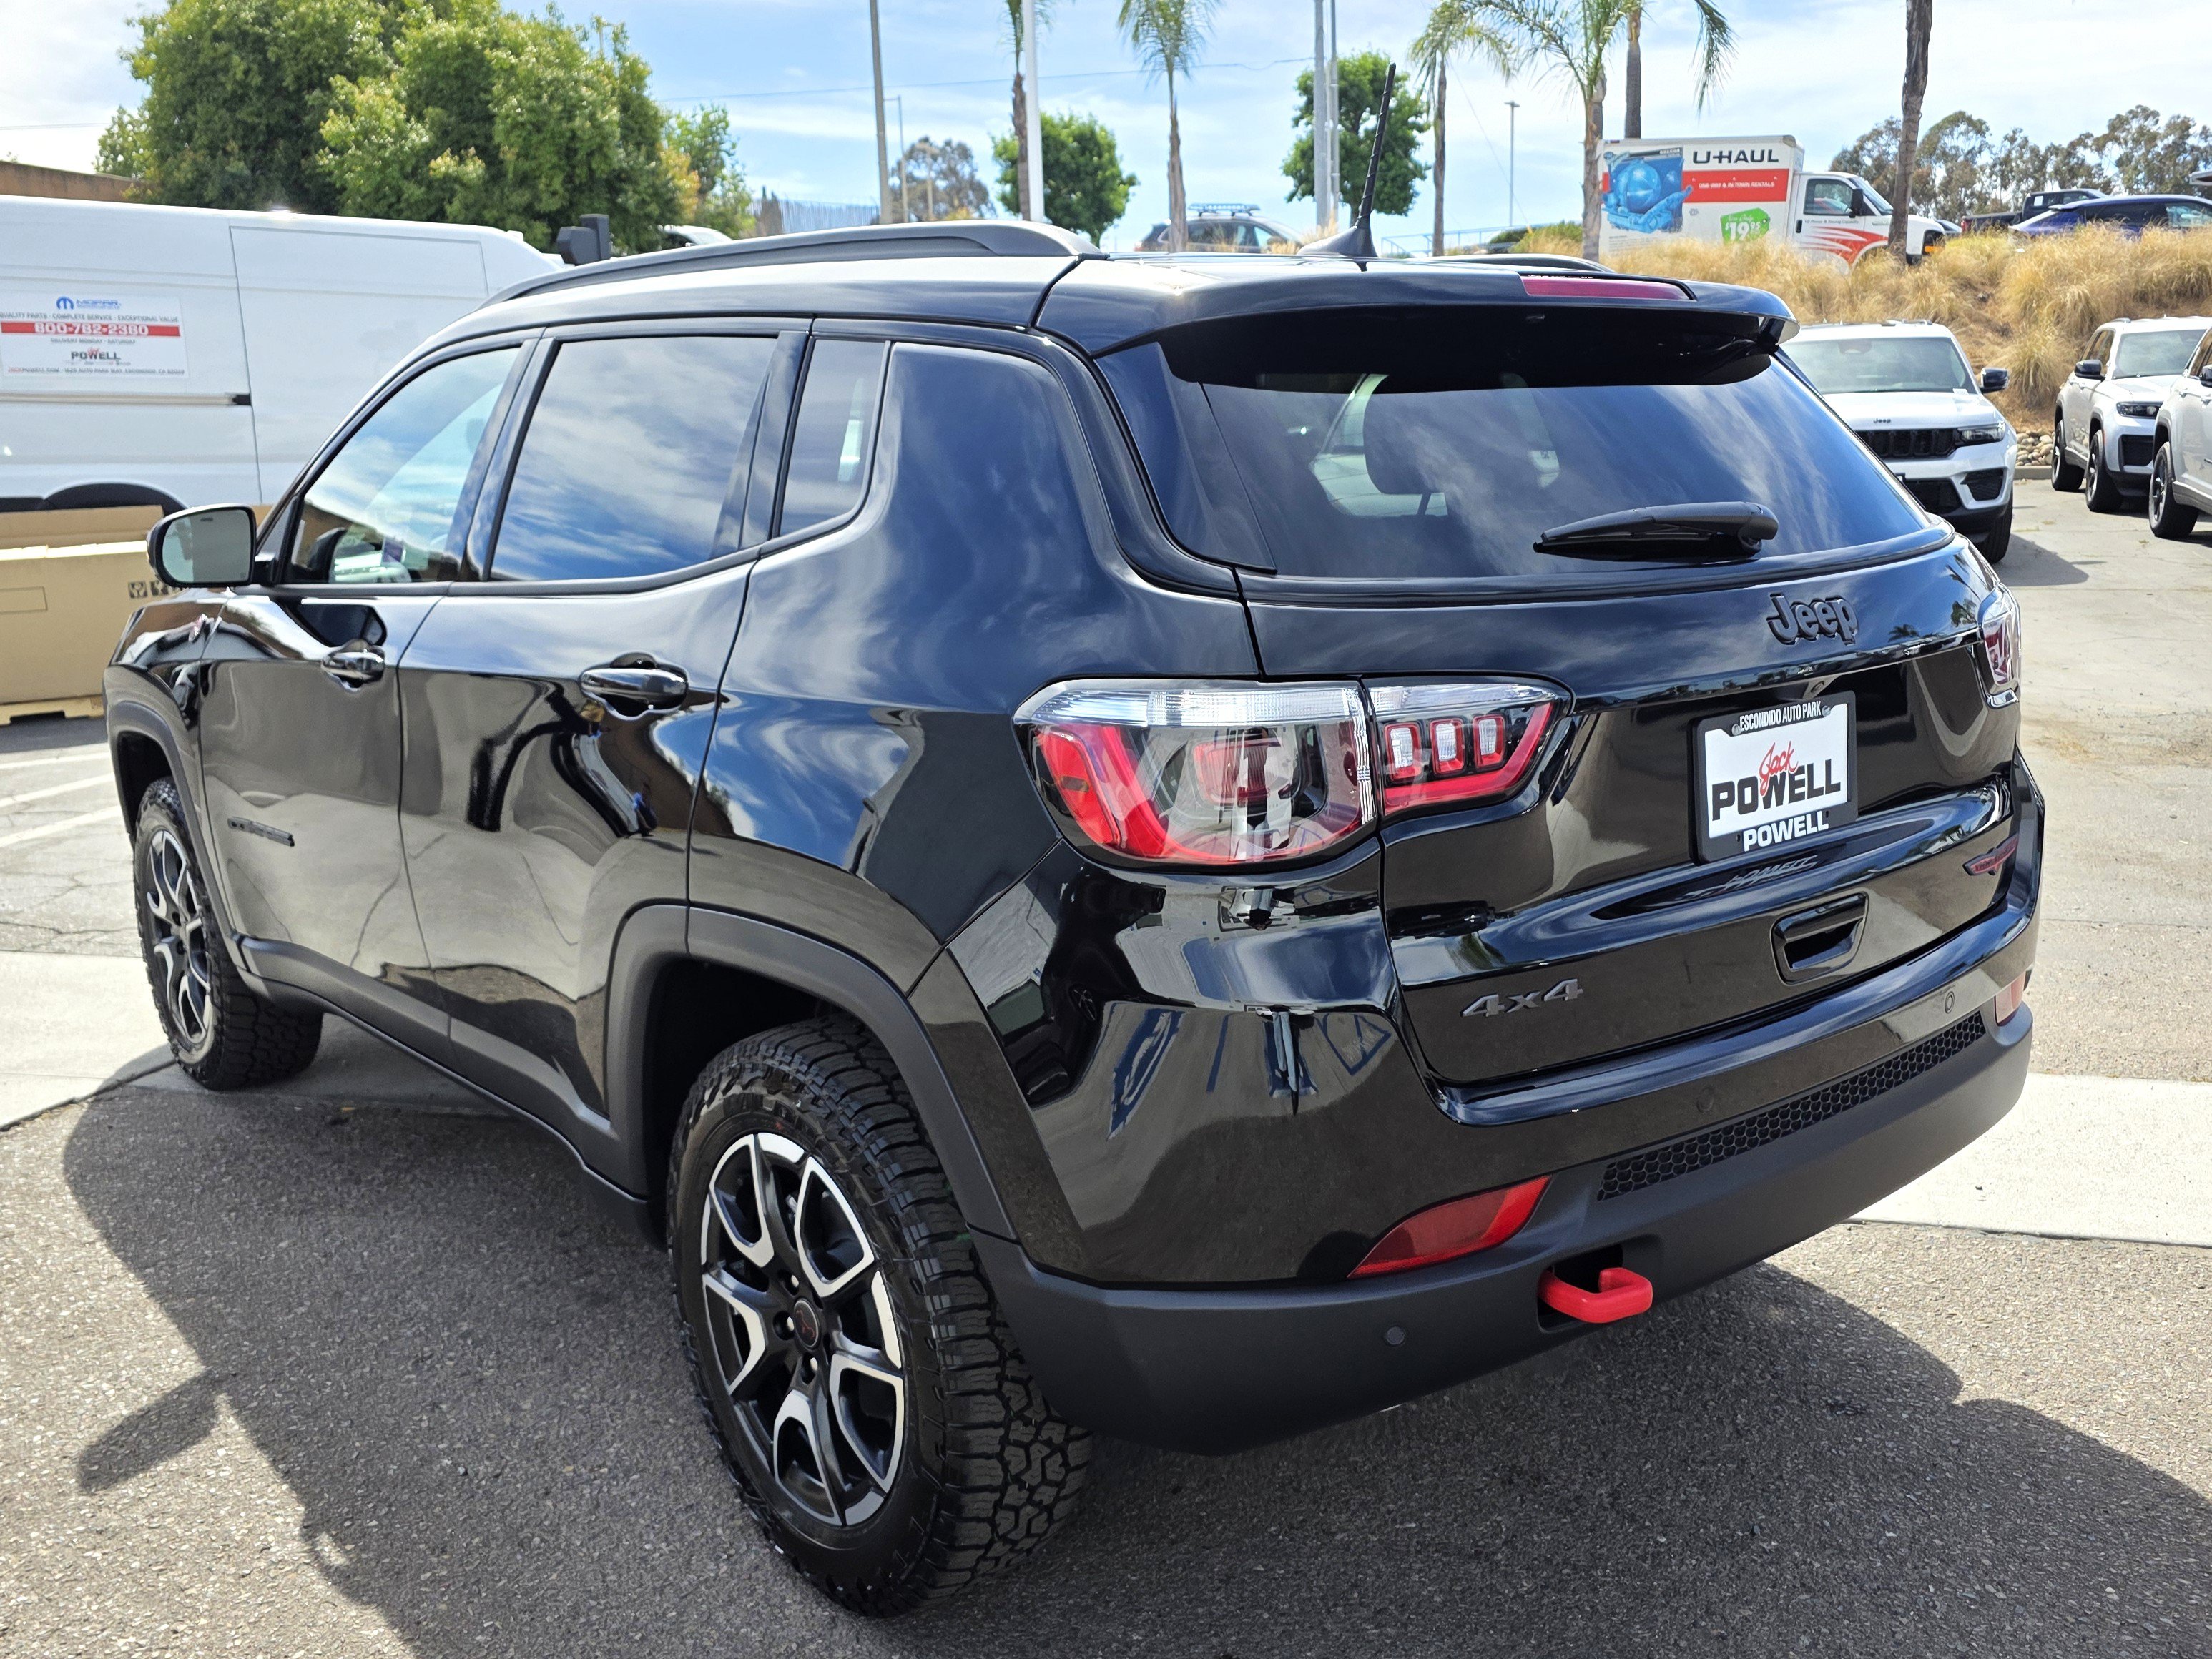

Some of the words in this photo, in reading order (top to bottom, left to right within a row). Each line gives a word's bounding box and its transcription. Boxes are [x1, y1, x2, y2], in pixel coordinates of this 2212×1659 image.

[1693, 148, 1779, 164] U-HAUL
[34, 322, 149, 336] 800-782-2380
[70, 351, 122, 360] POWELL
[1766, 592, 1858, 646] Jeep
[1739, 712, 1781, 731] ESCONDIDO
[1781, 704, 1801, 724] AUTO
[1802, 700, 1822, 719] PARK
[1759, 740, 1799, 797] Jack
[1711, 759, 1842, 822] POWELL
[1743, 810, 1829, 852] POWELL
